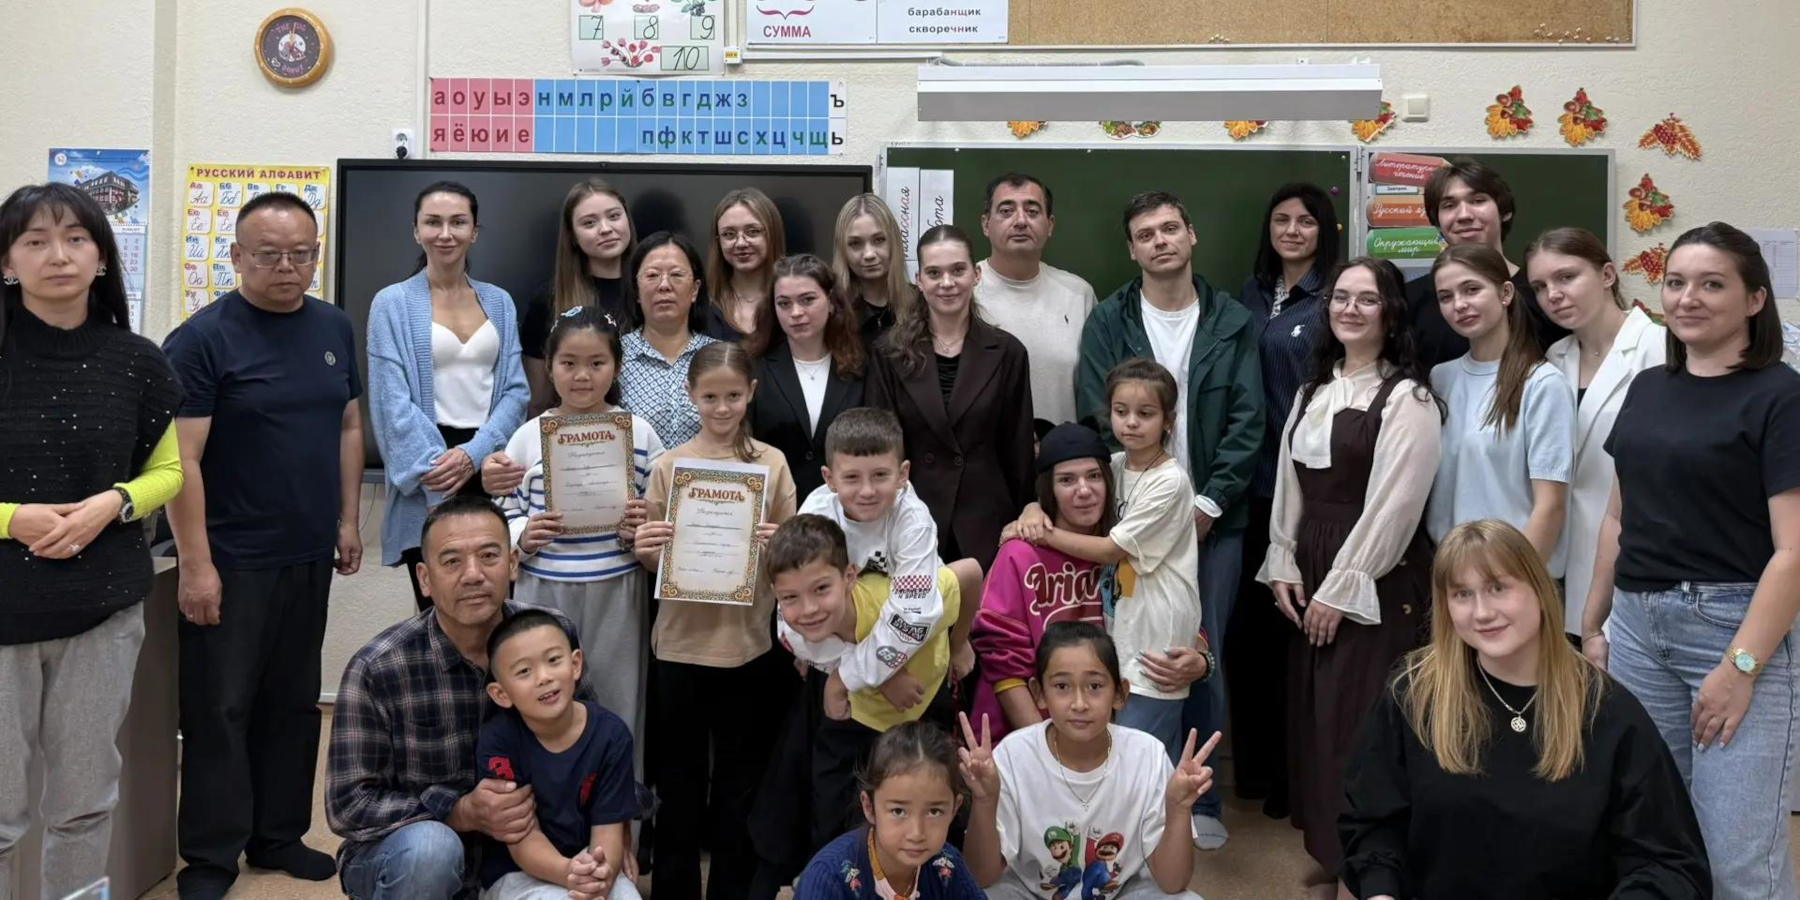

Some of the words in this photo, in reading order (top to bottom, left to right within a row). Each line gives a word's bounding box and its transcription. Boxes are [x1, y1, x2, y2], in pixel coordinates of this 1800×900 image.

[908, 7, 981, 17] барабанщик
[590, 15, 604, 40] 7
[643, 15, 659, 39] 8
[700, 15, 715, 40] 9
[763, 25, 811, 38] СУММА
[908, 24, 978, 34] скворечник
[673, 46, 700, 70] 10
[434, 91, 445, 105] а
[453, 91, 465, 106] о
[473, 91, 485, 110] у
[494, 92, 511, 106] ы
[518, 92, 530, 106] э
[539, 93, 550, 106] н
[558, 93, 573, 106] м
[579, 93, 593, 107] л
[600, 93, 612, 111] р
[621, 88, 633, 107] й
[641, 88, 654, 107] б
[663, 93, 675, 107] в
[682, 93, 692, 107] г
[697, 93, 711, 110] д
[715, 93, 731, 107] ж
[737, 93, 748, 107] з
[830, 94, 845, 108] ъ
[433, 128, 445, 142] я
[453, 123, 465, 142] ё
[471, 128, 489, 142] ю
[496, 128, 508, 142] и
[518, 128, 530, 143] е
[642, 131, 653, 145] п
[657, 126, 676, 149] ф
[682, 131, 692, 145] к
[698, 131, 709, 145] т
[715, 131, 731, 145] ш
[737, 131, 748, 145] с
[755, 131, 768, 145] х
[773, 131, 786, 149] ц
[792, 131, 803, 145] ч
[809, 131, 828, 149] щ
[832, 131, 844, 145] ь
[1375, 159, 1438, 173] Литературн
[196, 168, 255, 179] РУССКИЙ
[260, 169, 321, 180] АЛФАВИТ
[1372, 203, 1412, 218] Русский
[1398, 247, 1420, 256] мир
[557, 430, 615, 445] ГРАМОТА
[688, 487, 745, 502] ГРАМОТА
[1024, 561, 1101, 616] Aria
